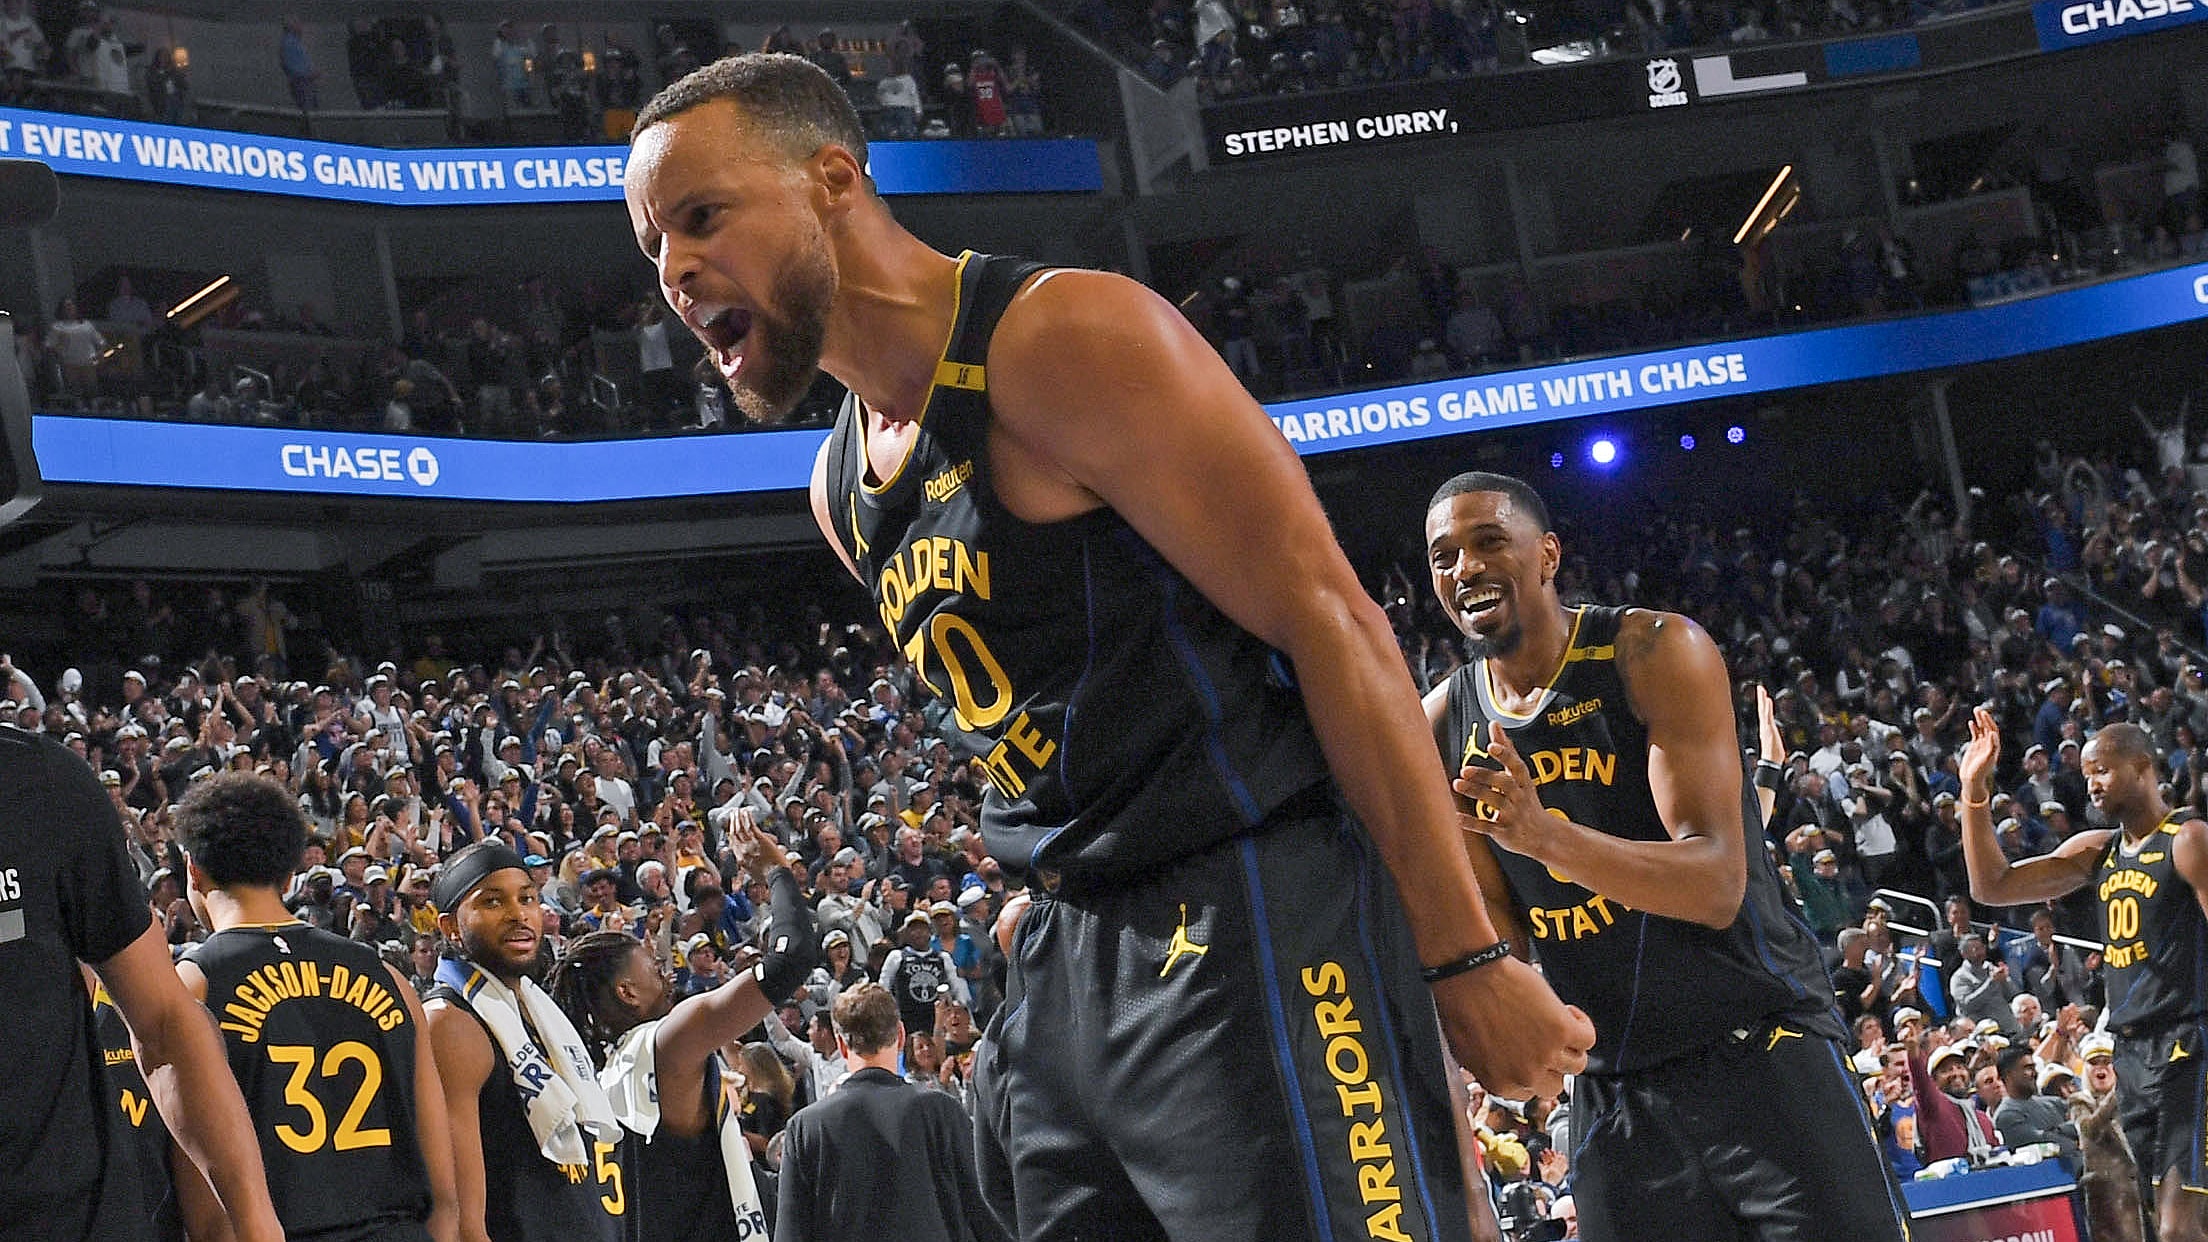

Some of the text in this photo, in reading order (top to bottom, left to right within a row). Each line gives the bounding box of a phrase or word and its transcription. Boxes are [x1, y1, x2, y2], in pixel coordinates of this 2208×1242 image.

[1224, 109, 1458, 156] STEPHEN CURRY,
[21, 123, 122, 163] EVERY
[131, 135, 307, 181] WARRIORS
[313, 155, 404, 191] GAME
[409, 162, 505, 191] WITH
[514, 158, 624, 189] CHASE
[1271, 354, 1747, 443] ARRIORS GAME WITH CHASE
[281, 444, 405, 481] CHASE
[924, 460, 975, 502] Rakuten
[1548, 697, 1602, 727] Rakuten
[2099, 869, 2159, 902] GOLDEN
[1529, 893, 1632, 942] STAT
[2108, 896, 2139, 940] 00
[905, 963, 941, 977] TOWN
[2103, 940, 2149, 968] STATE
[219, 960, 404, 1043] JACKSON-DAVIS
[267, 1040, 392, 1154] 32
[594, 1141, 626, 1215] 5
